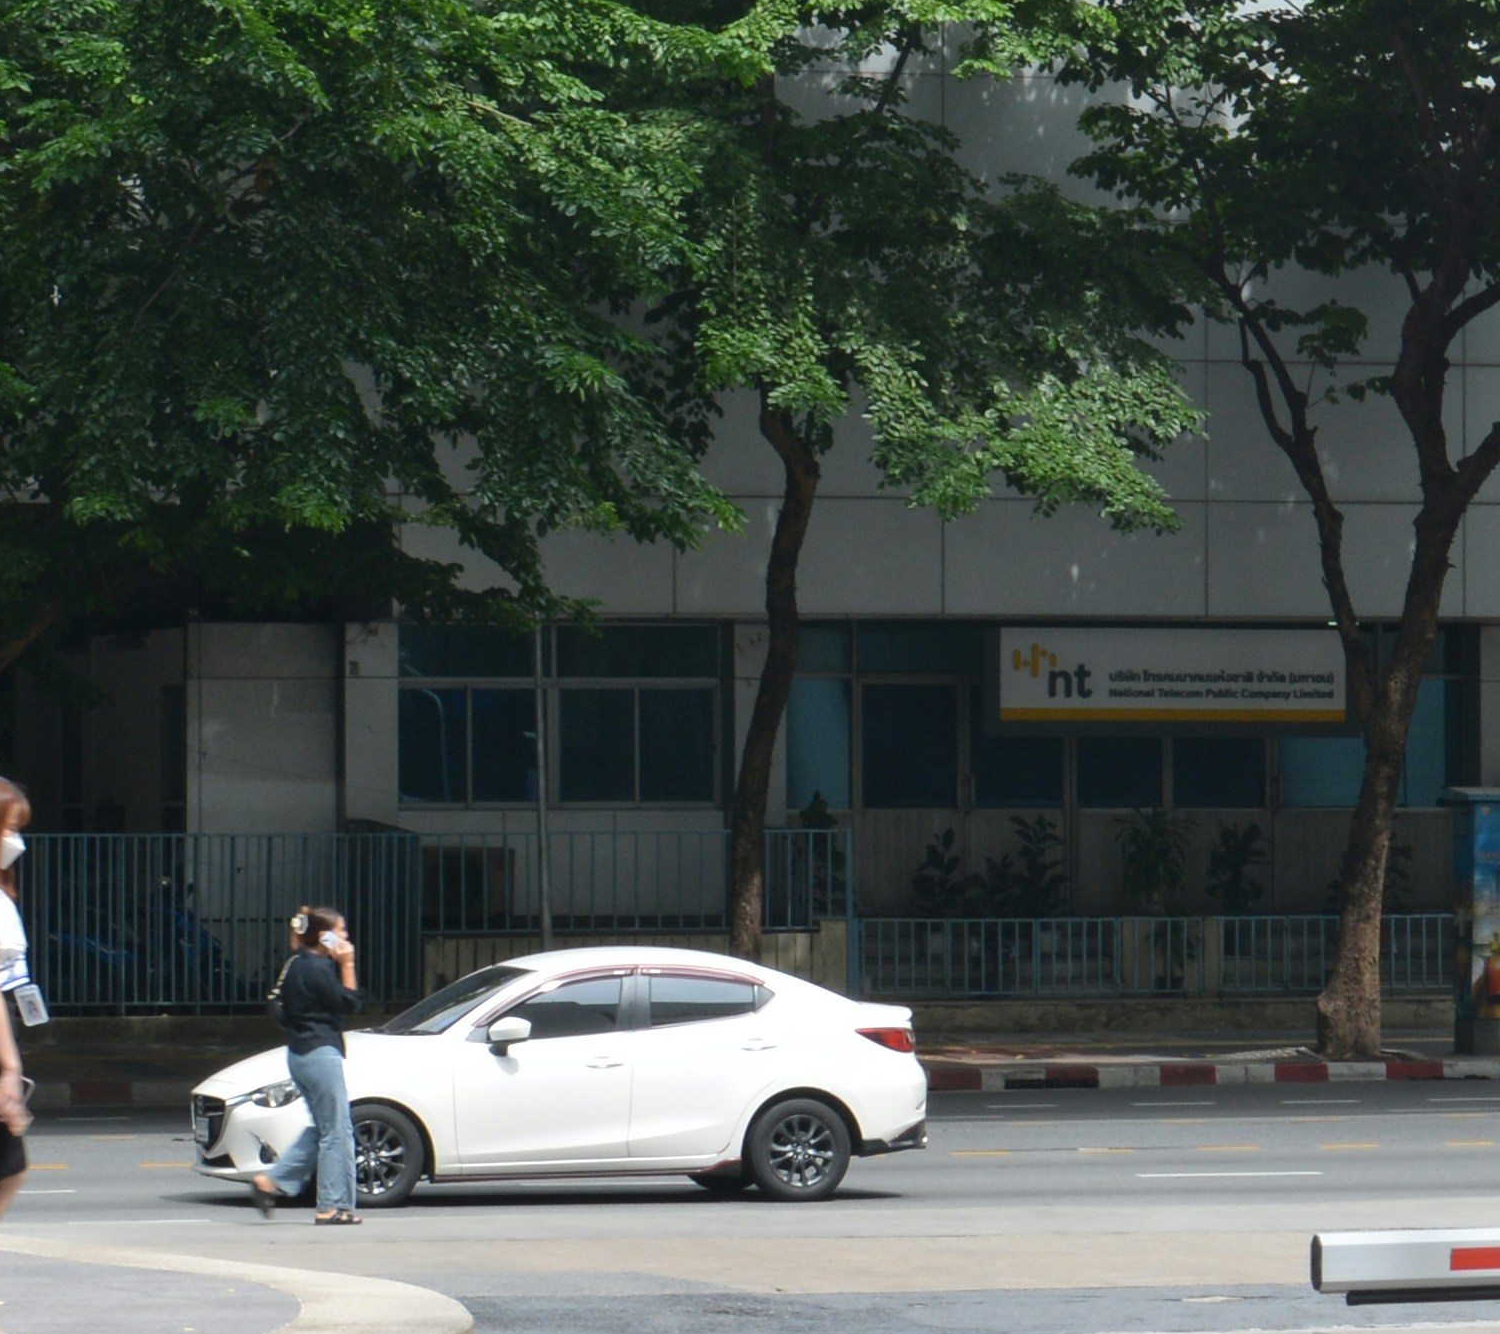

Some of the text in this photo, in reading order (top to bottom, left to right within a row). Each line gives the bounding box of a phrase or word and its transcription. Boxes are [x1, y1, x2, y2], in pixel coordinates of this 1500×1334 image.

[1048, 663, 1093, 700] nt
[1108, 687, 1335, 701] National Telecom Public Company Limited
